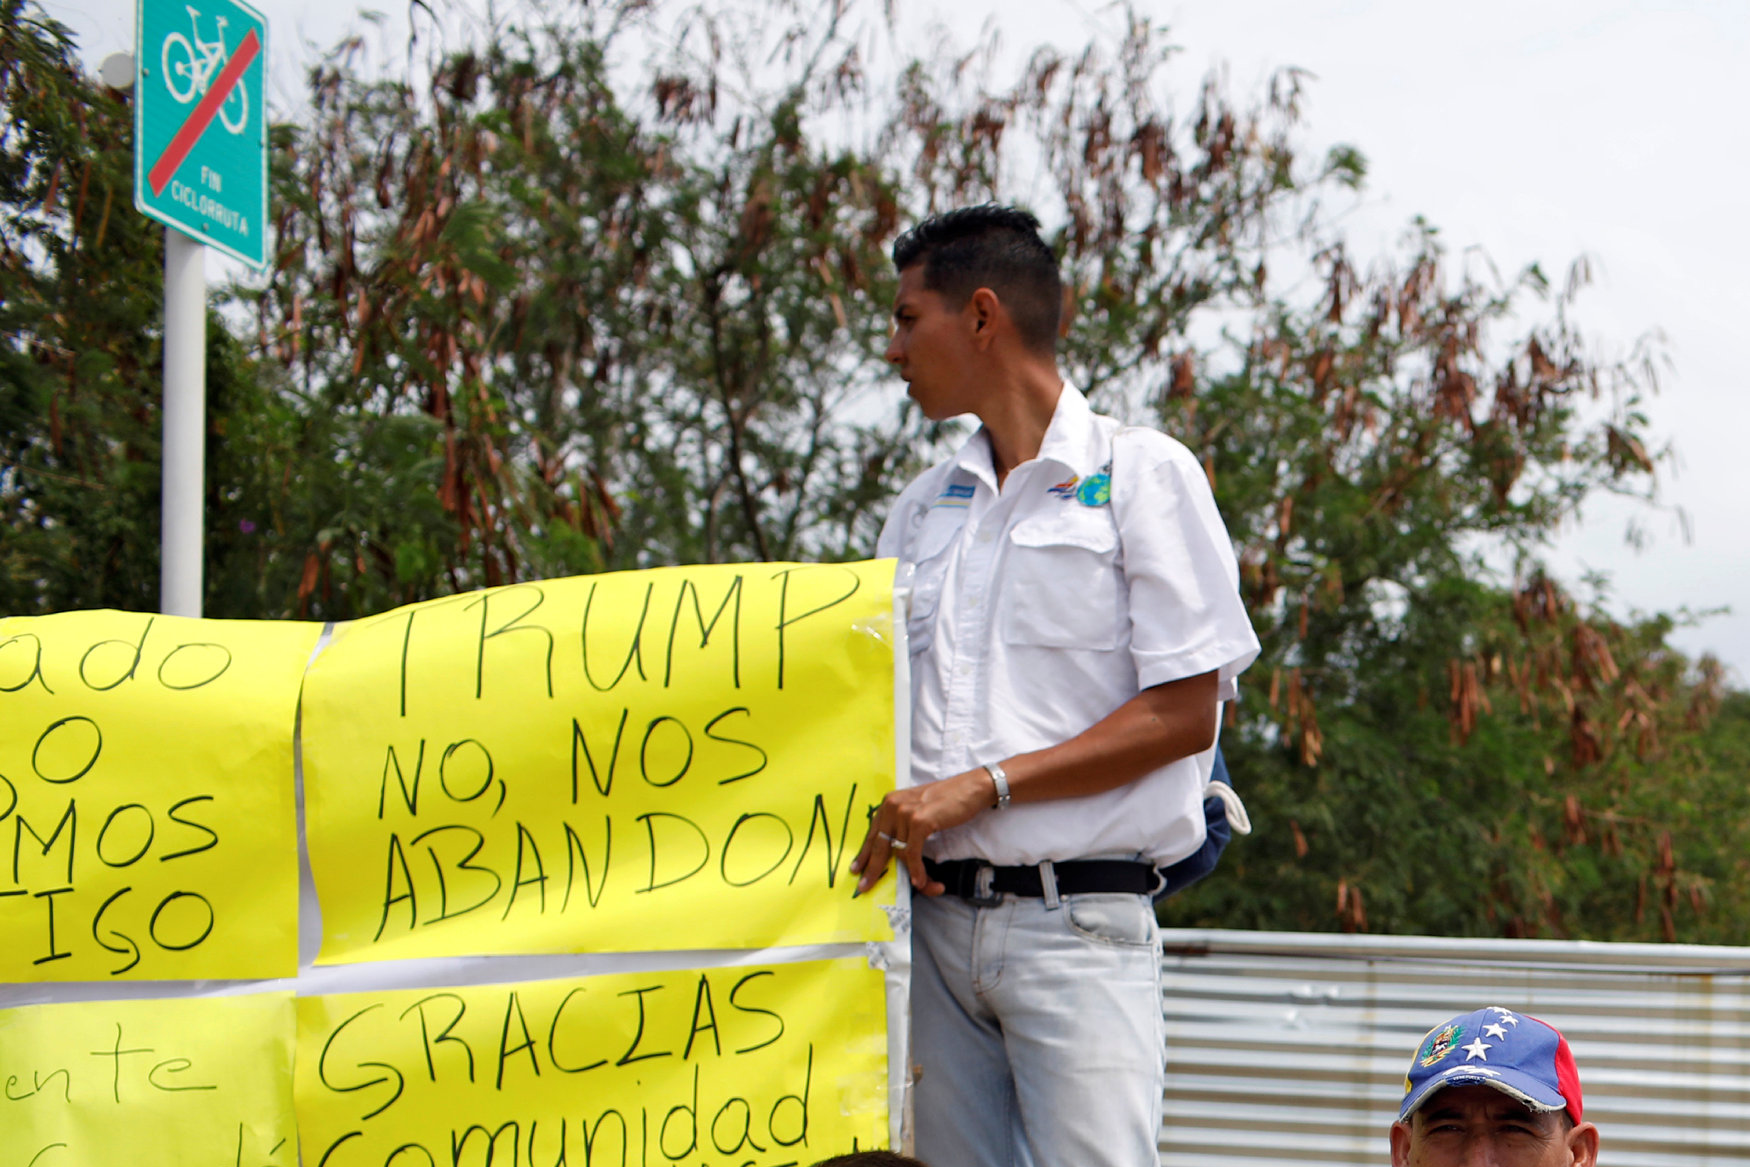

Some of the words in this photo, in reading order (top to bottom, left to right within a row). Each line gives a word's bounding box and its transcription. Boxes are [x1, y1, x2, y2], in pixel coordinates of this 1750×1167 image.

[171, 180, 249, 237] CICLORRUTA
[201, 165, 222, 193] FIN
[365, 567, 860, 717] TRUMP
[378, 738, 507, 819] NO,
[571, 706, 768, 804] NOS
[373, 783, 888, 942] ABANDON
[319, 971, 785, 1121] GRACIAS
